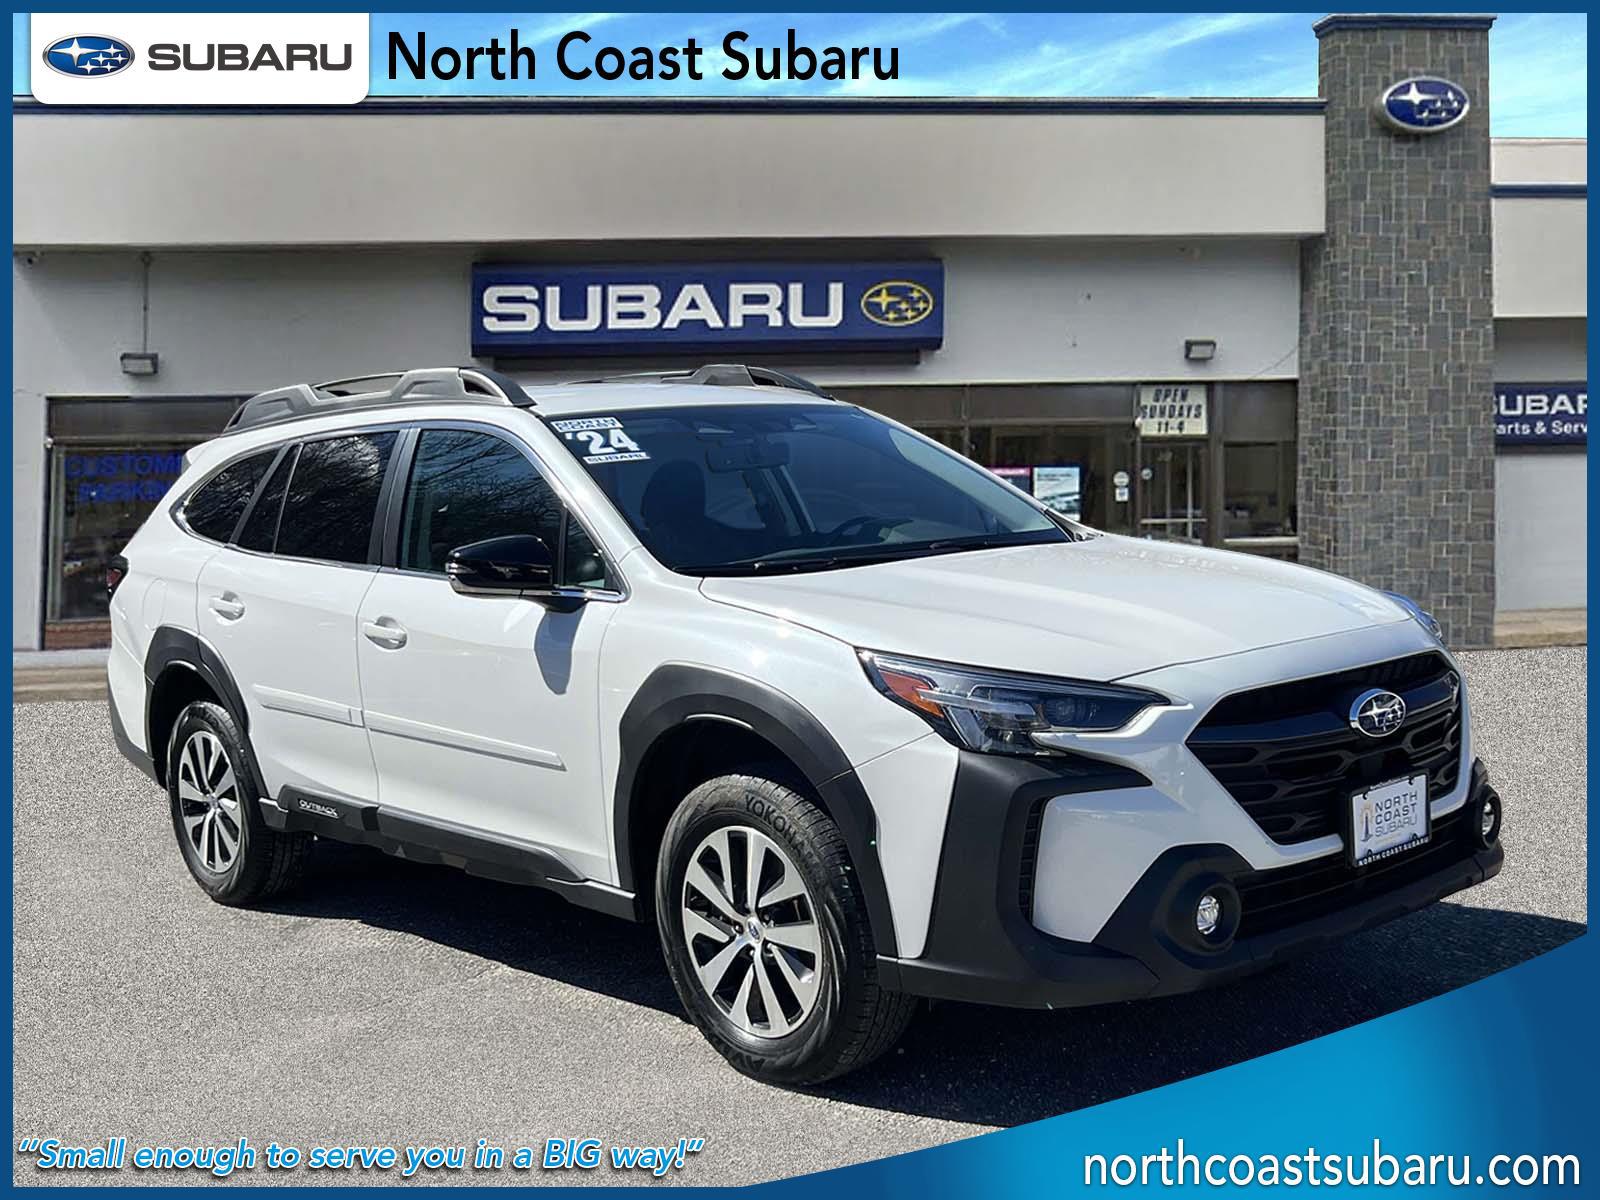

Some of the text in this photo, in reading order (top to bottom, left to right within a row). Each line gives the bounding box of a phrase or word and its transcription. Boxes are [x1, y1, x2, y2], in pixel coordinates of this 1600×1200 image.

[482, 282, 843, 332] SUBARU
[1154, 388, 1189, 403] OPEN
[1495, 421, 1531, 435] arts
[1534, 420, 1547, 434] &
[1375, 790, 1418, 813] NORTH
[1375, 803, 1417, 825] COAST
[1375, 815, 1418, 837] SUBARU
